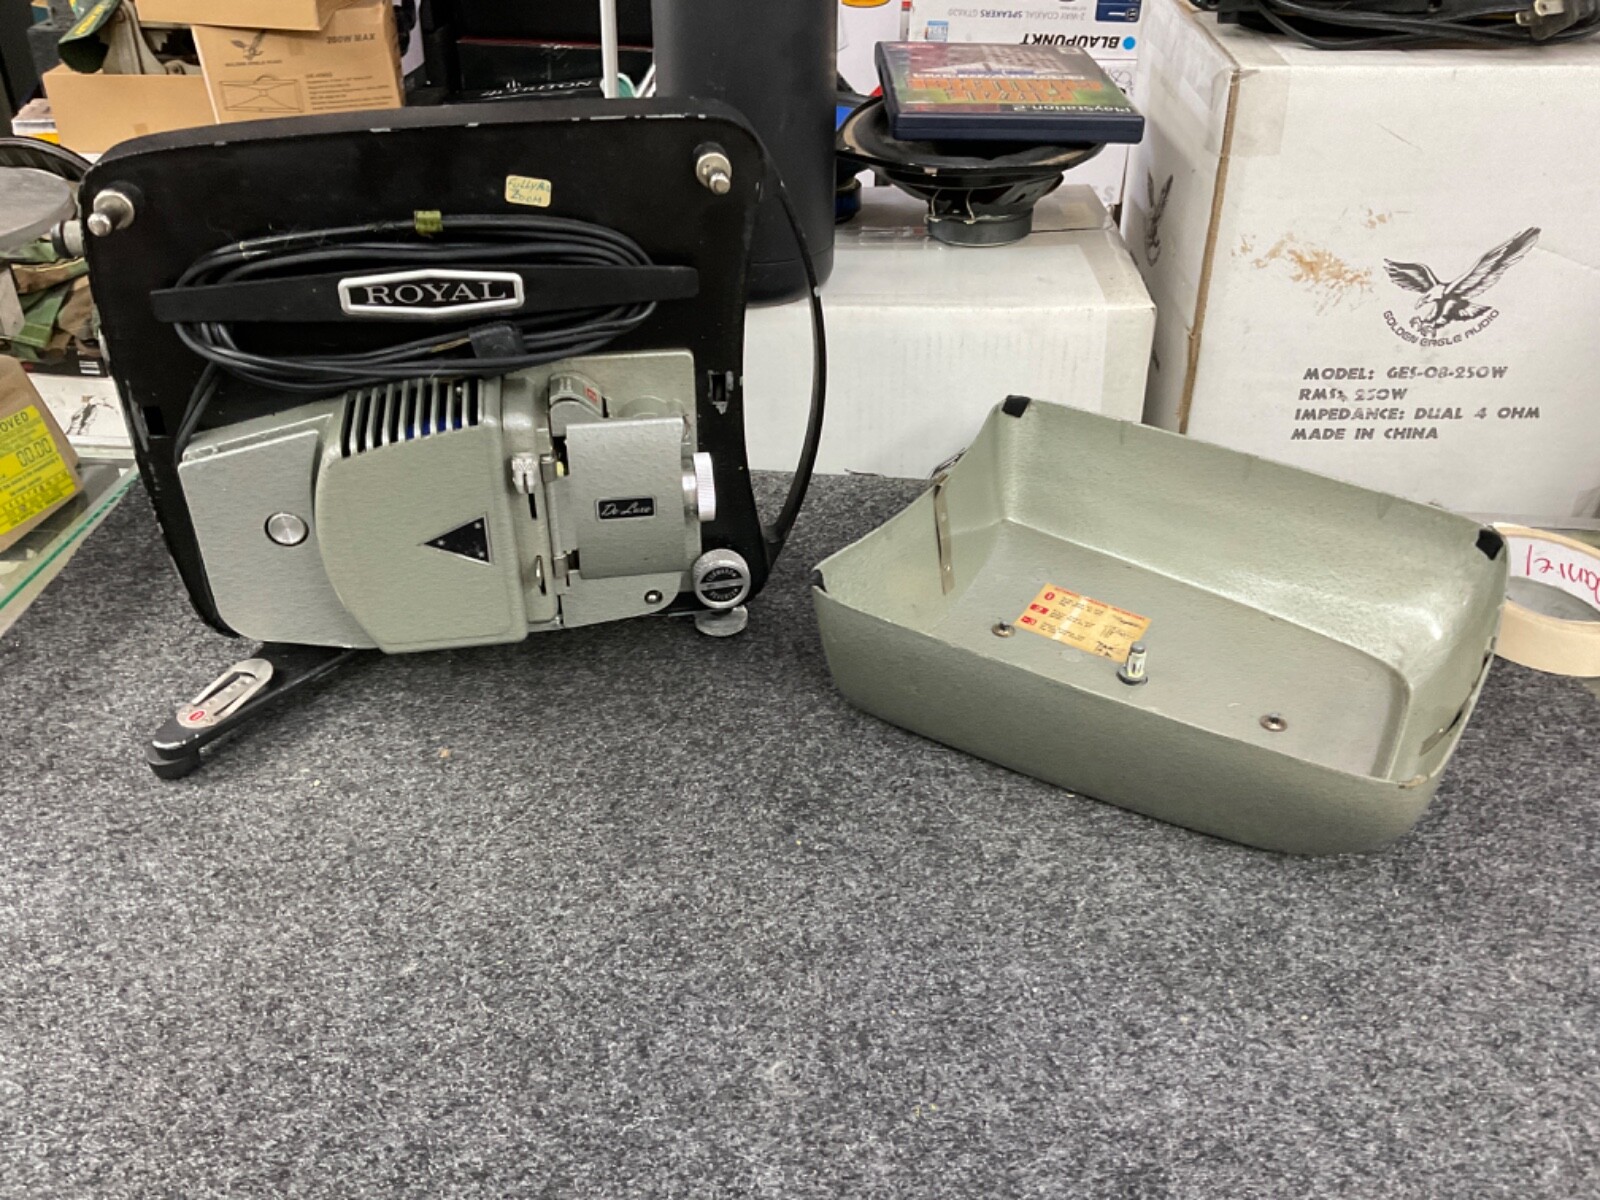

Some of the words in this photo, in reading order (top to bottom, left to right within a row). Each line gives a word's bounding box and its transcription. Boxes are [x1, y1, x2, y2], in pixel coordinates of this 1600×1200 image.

[980, 10, 1023, 18] SPEAKERS
[1020, 33, 1120, 49] BLAUPUNKT
[1032, 104, 1131, 113] PlayStation
[363, 281, 506, 305] ROYAL
[1383, 310, 1419, 344] GOLDEN
[1419, 334, 1463, 347] EAGLE
[1464, 309, 1500, 340] AUDIO
[1303, 367, 1375, 381] MODEL:
[1294, 407, 1405, 421] IMPEDANCE:
[1414, 407, 1463, 420] DUAL
[1474, 407, 1487, 419] 4
[1497, 406, 1541, 420] OHM
[1290, 427, 1346, 441] MADE
[1354, 427, 1375, 440] IN
[1384, 427, 1439, 440] CHINA
